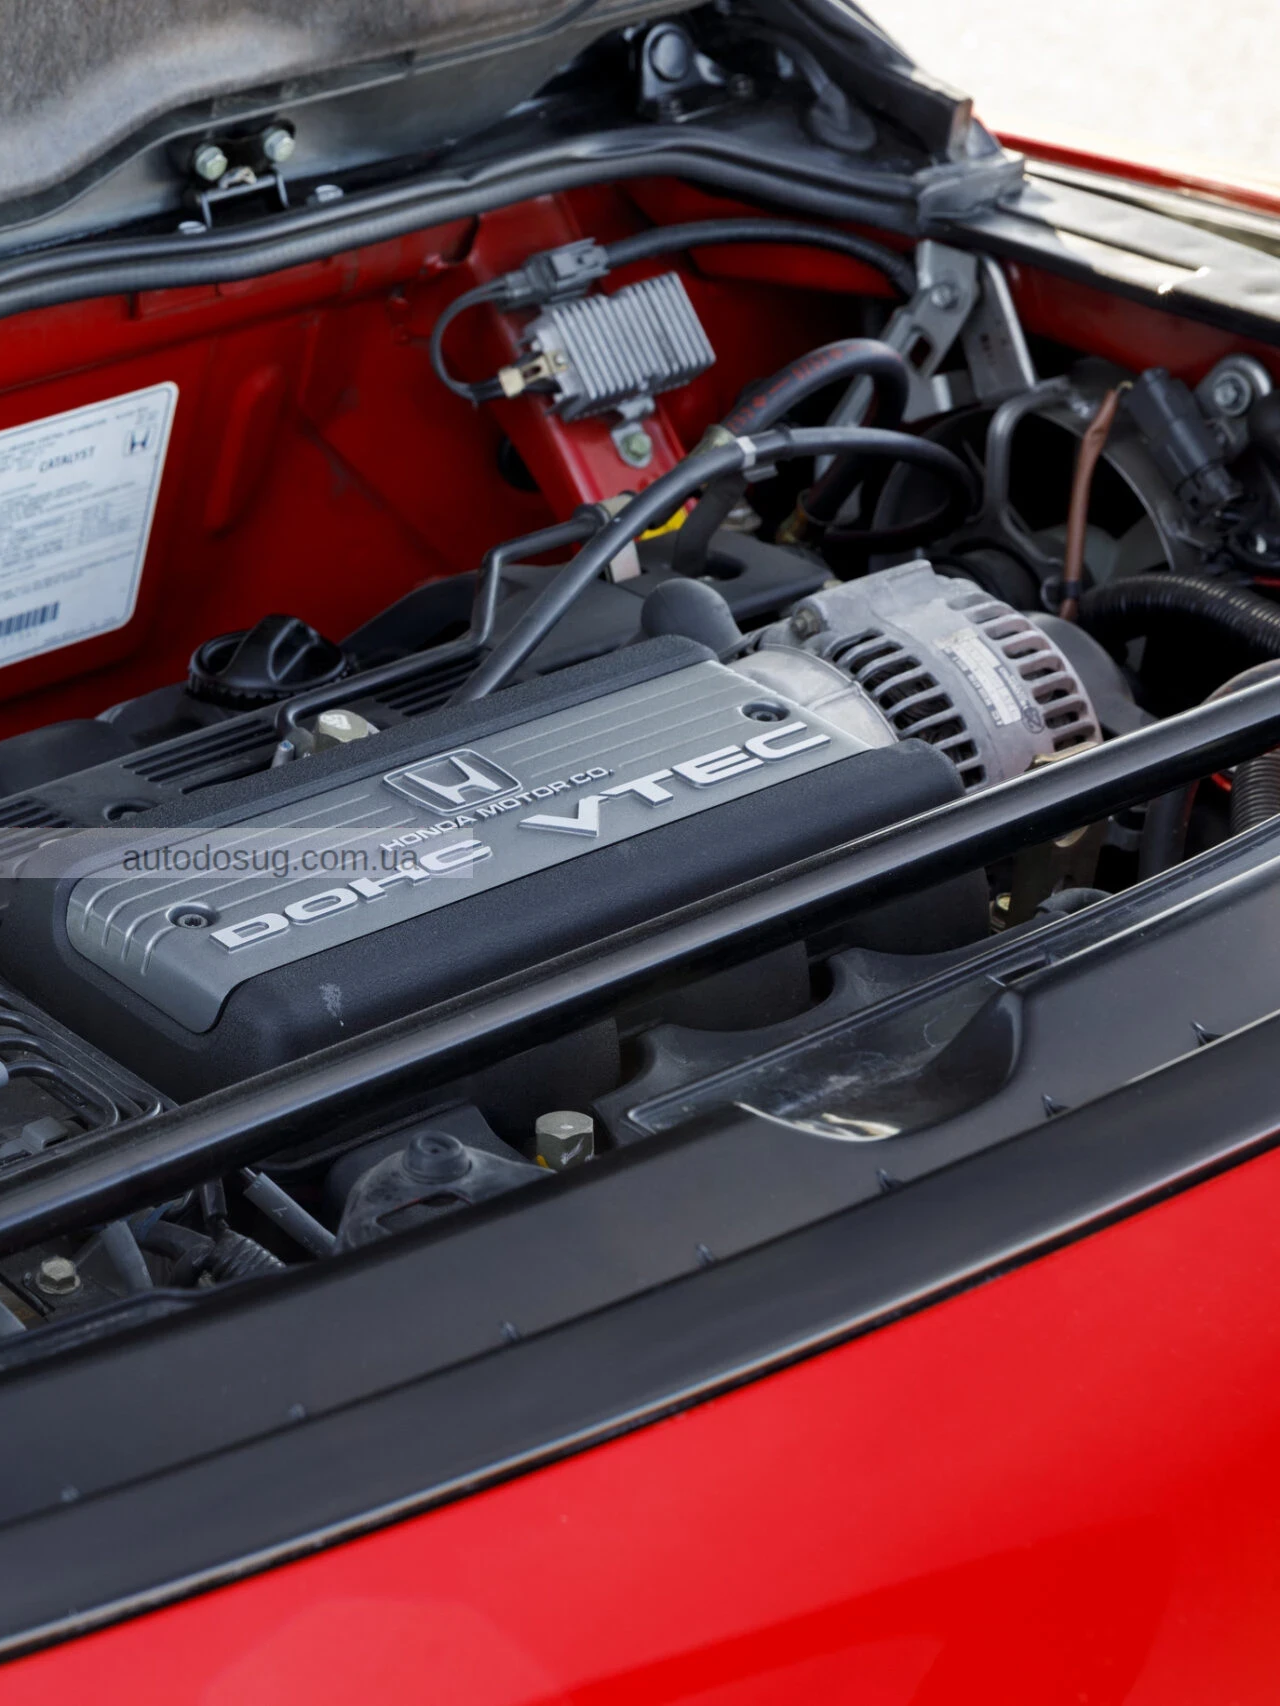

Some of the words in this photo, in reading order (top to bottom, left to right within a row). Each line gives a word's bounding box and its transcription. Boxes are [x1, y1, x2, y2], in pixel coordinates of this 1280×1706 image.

[39, 446, 97, 474] CATALYST
[210, 838, 494, 952] DOHC
[519, 720, 831, 838] VTEC
[380, 813, 477, 855] HONDA
[476, 778, 571, 821] MOTOR
[568, 765, 616, 789] CO.
